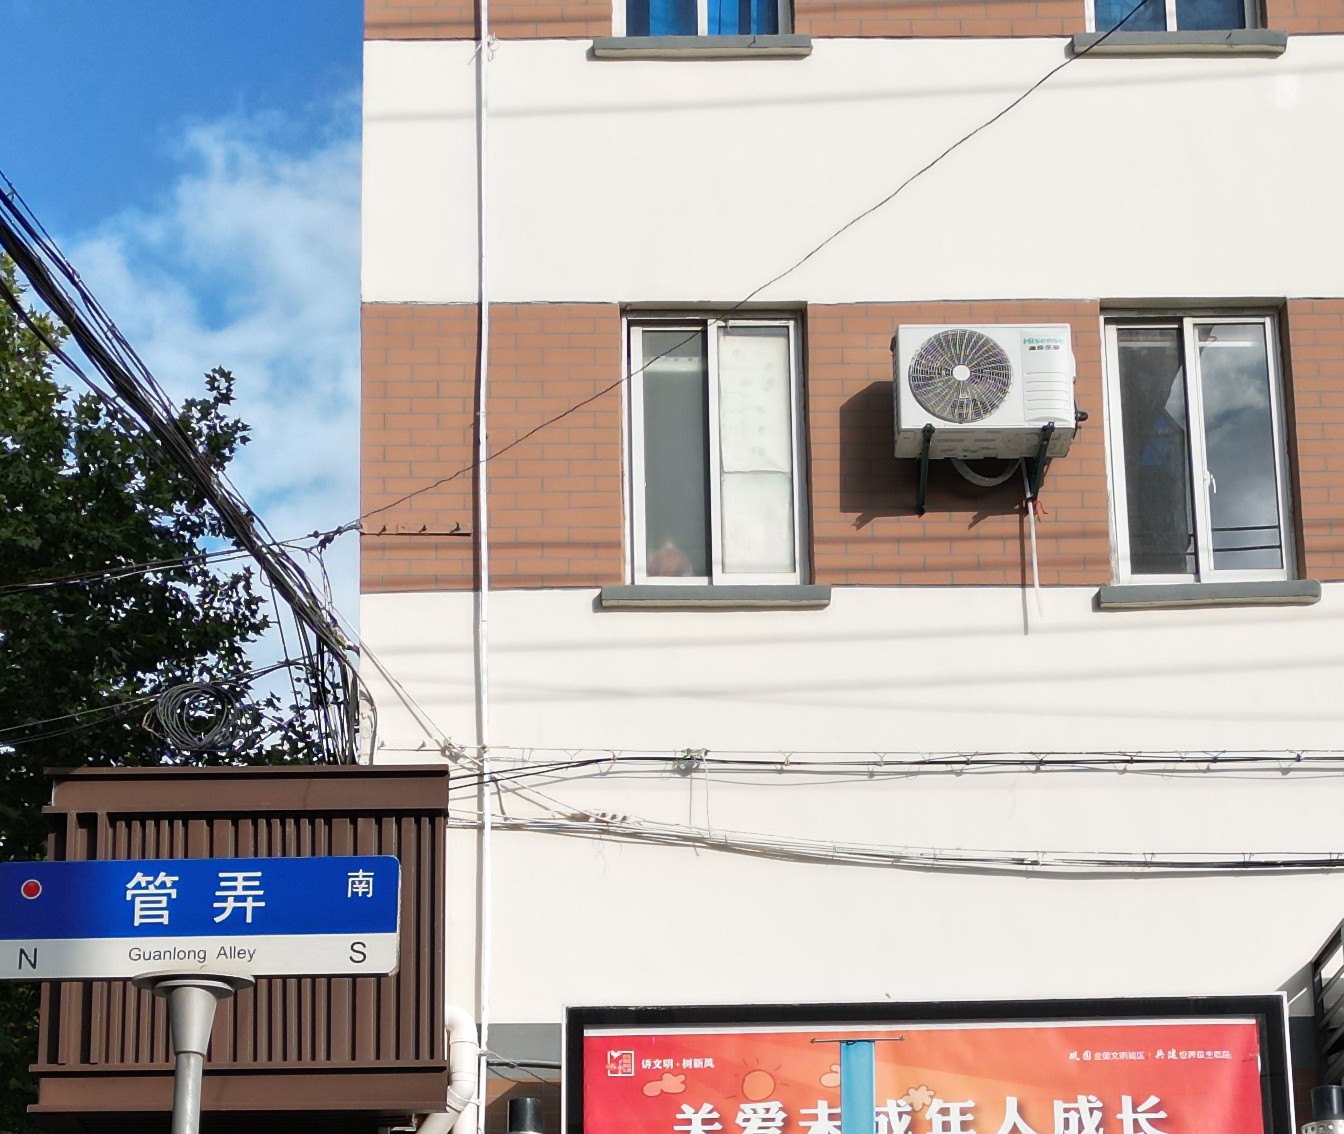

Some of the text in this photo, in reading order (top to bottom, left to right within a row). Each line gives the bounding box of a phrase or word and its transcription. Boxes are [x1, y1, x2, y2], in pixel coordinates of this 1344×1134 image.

[124, 869, 375, 927] 管弄 南
[17, 941, 368, 970] N Guanlong Alley S
